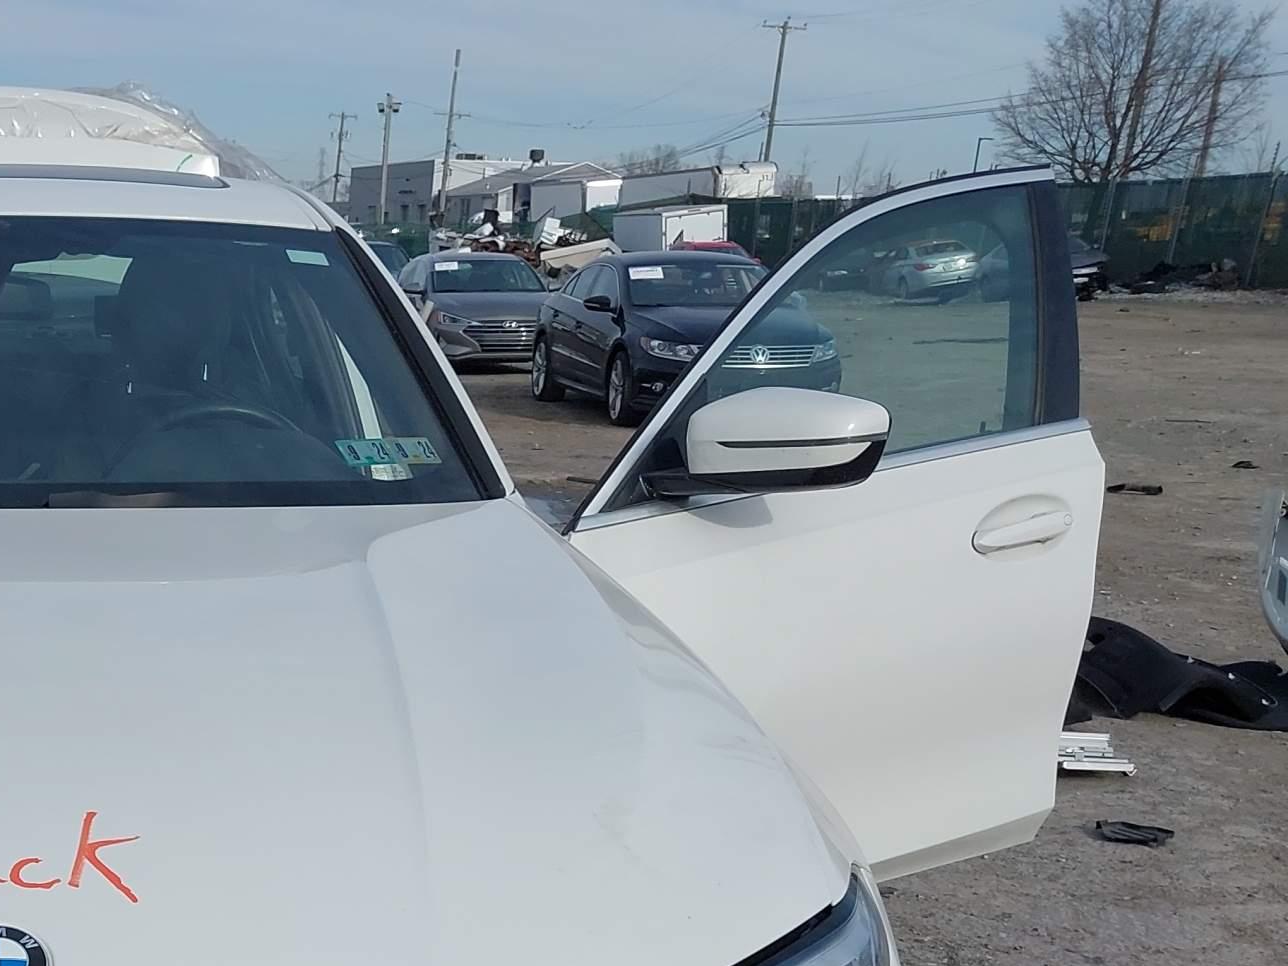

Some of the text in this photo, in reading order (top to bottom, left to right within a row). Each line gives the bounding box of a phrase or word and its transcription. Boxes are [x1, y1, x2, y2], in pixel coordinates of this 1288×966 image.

[347, 442, 389, 461] 9 24
[395, 440, 437, 458] 9 24
